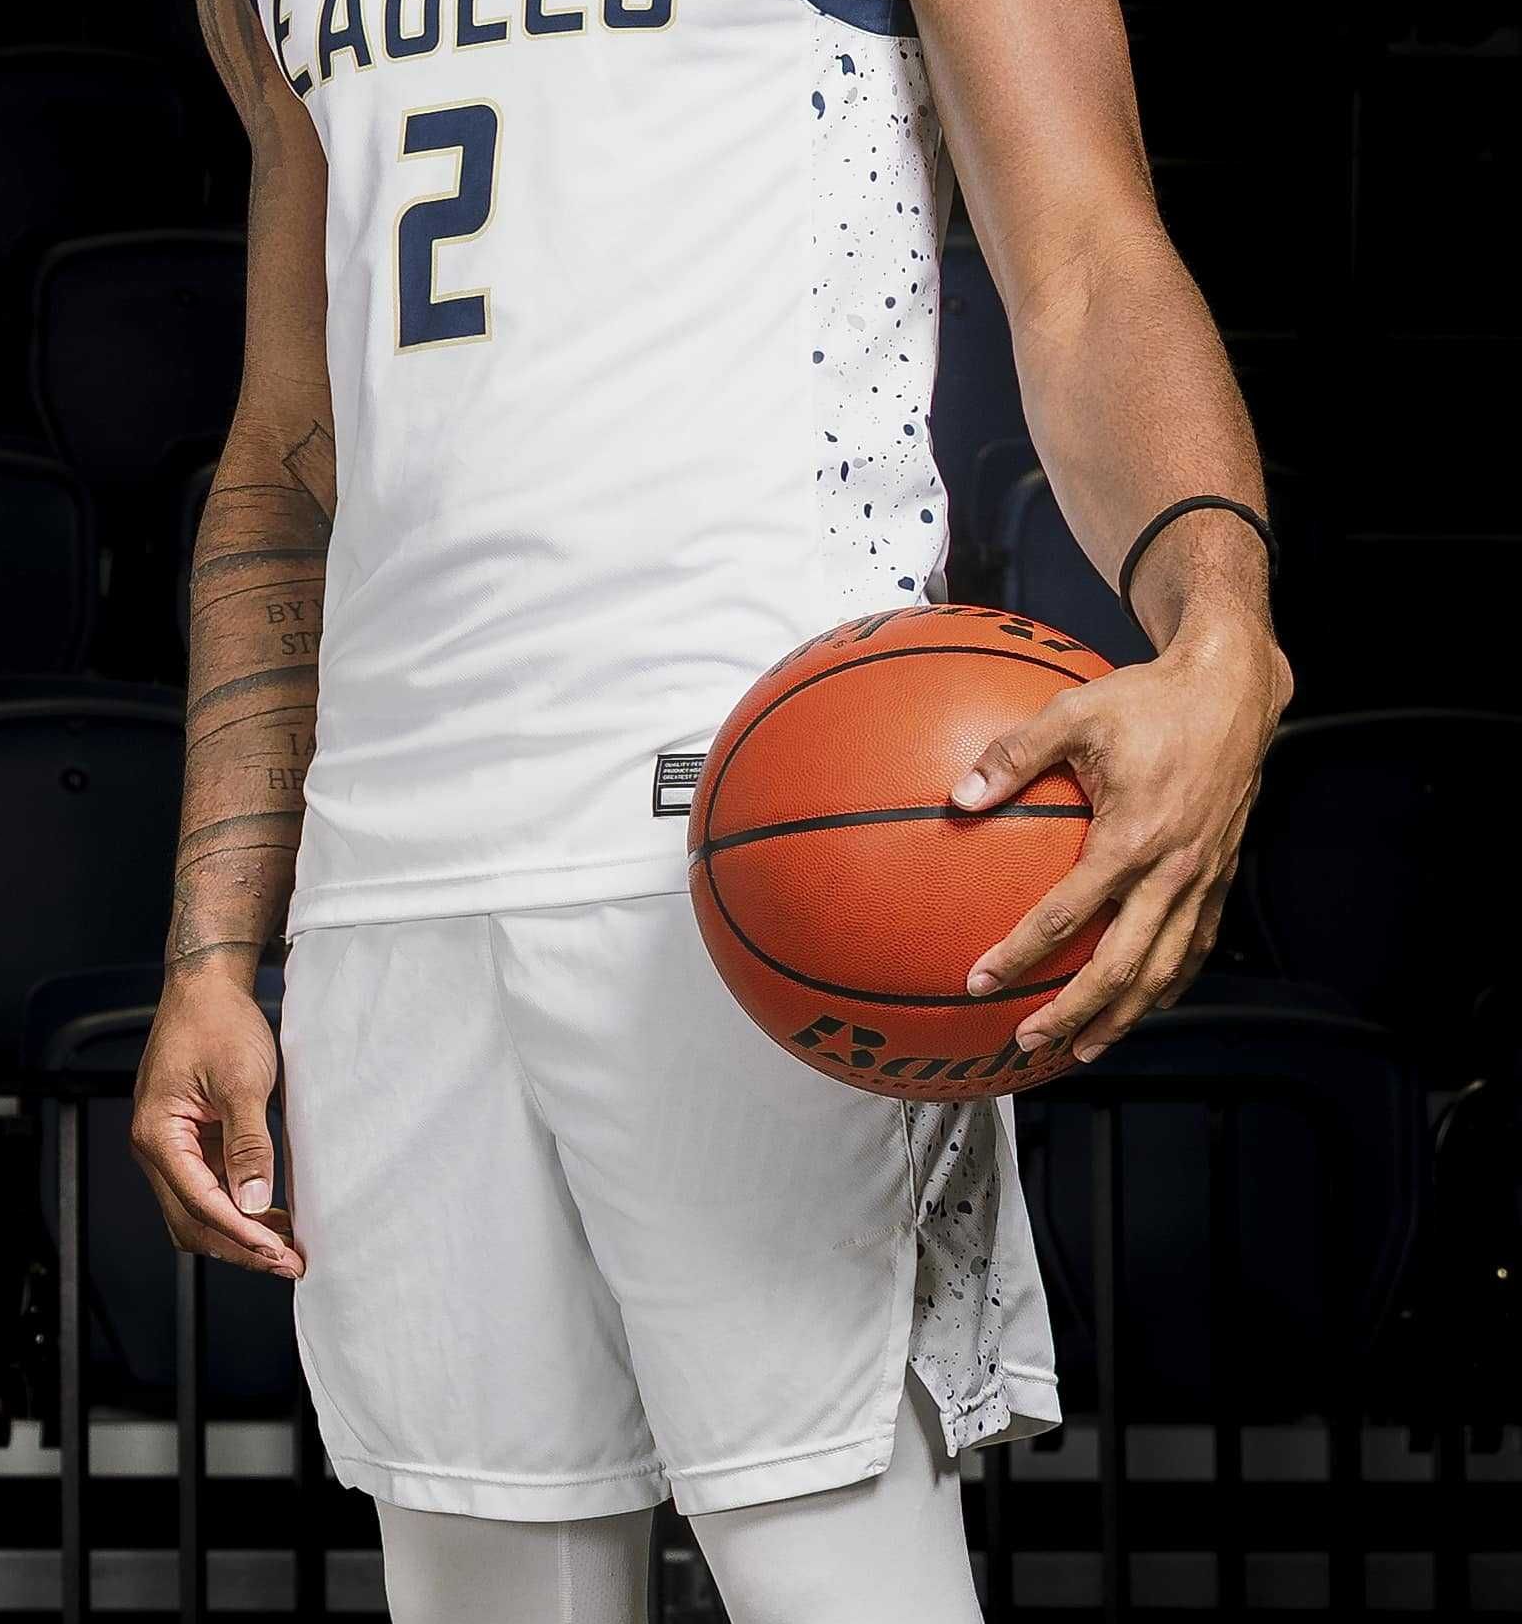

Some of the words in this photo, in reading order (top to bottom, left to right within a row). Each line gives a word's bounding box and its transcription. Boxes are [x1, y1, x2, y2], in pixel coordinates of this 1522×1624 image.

[395, 97, 504, 355] 2
[266, 601, 304, 624] BY
[790, 1014, 1070, 1081] Bade
